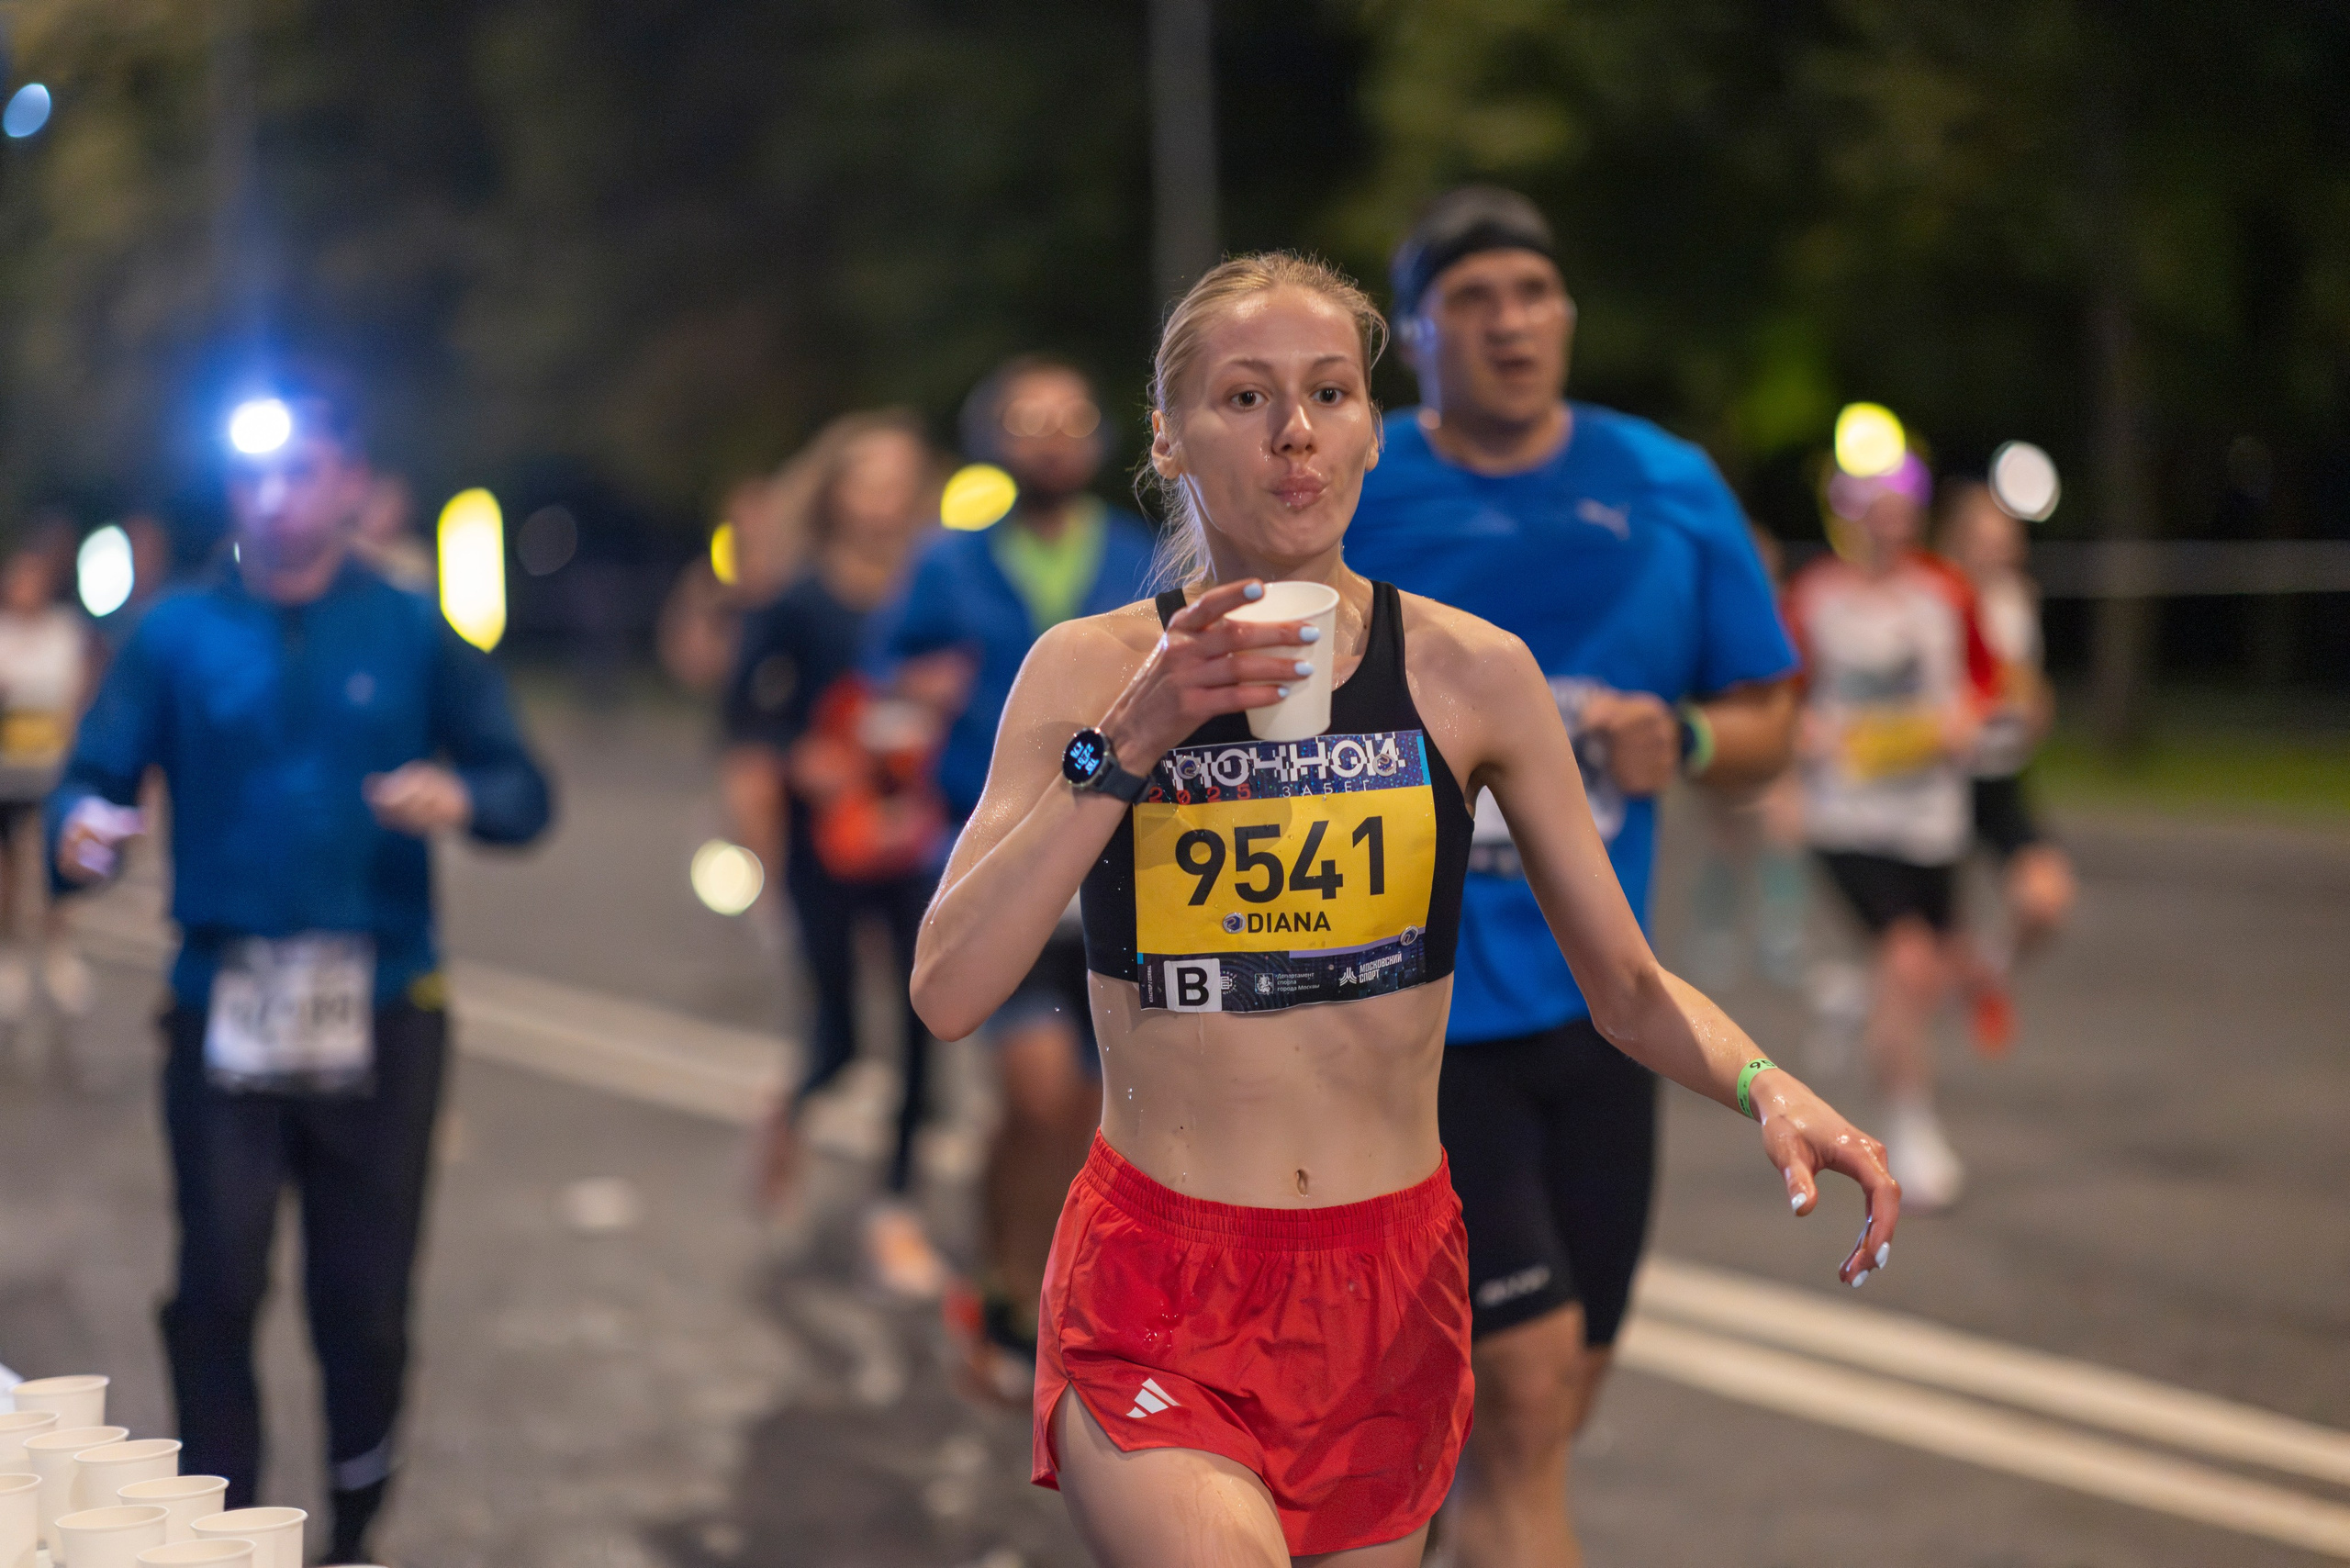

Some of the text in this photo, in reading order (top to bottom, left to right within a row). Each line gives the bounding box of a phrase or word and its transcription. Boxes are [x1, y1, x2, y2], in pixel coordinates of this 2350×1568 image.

[1148, 783, 1251, 805] 2025
[1282, 779, 1369, 799] ЗАБЕГ
[1175, 815, 1384, 906] 9541
[1248, 911, 1331, 934] DIANA
[1360, 951, 1403, 973] МОСКОВСКИЙ
[1359, 969, 1380, 983] СПОРТ
